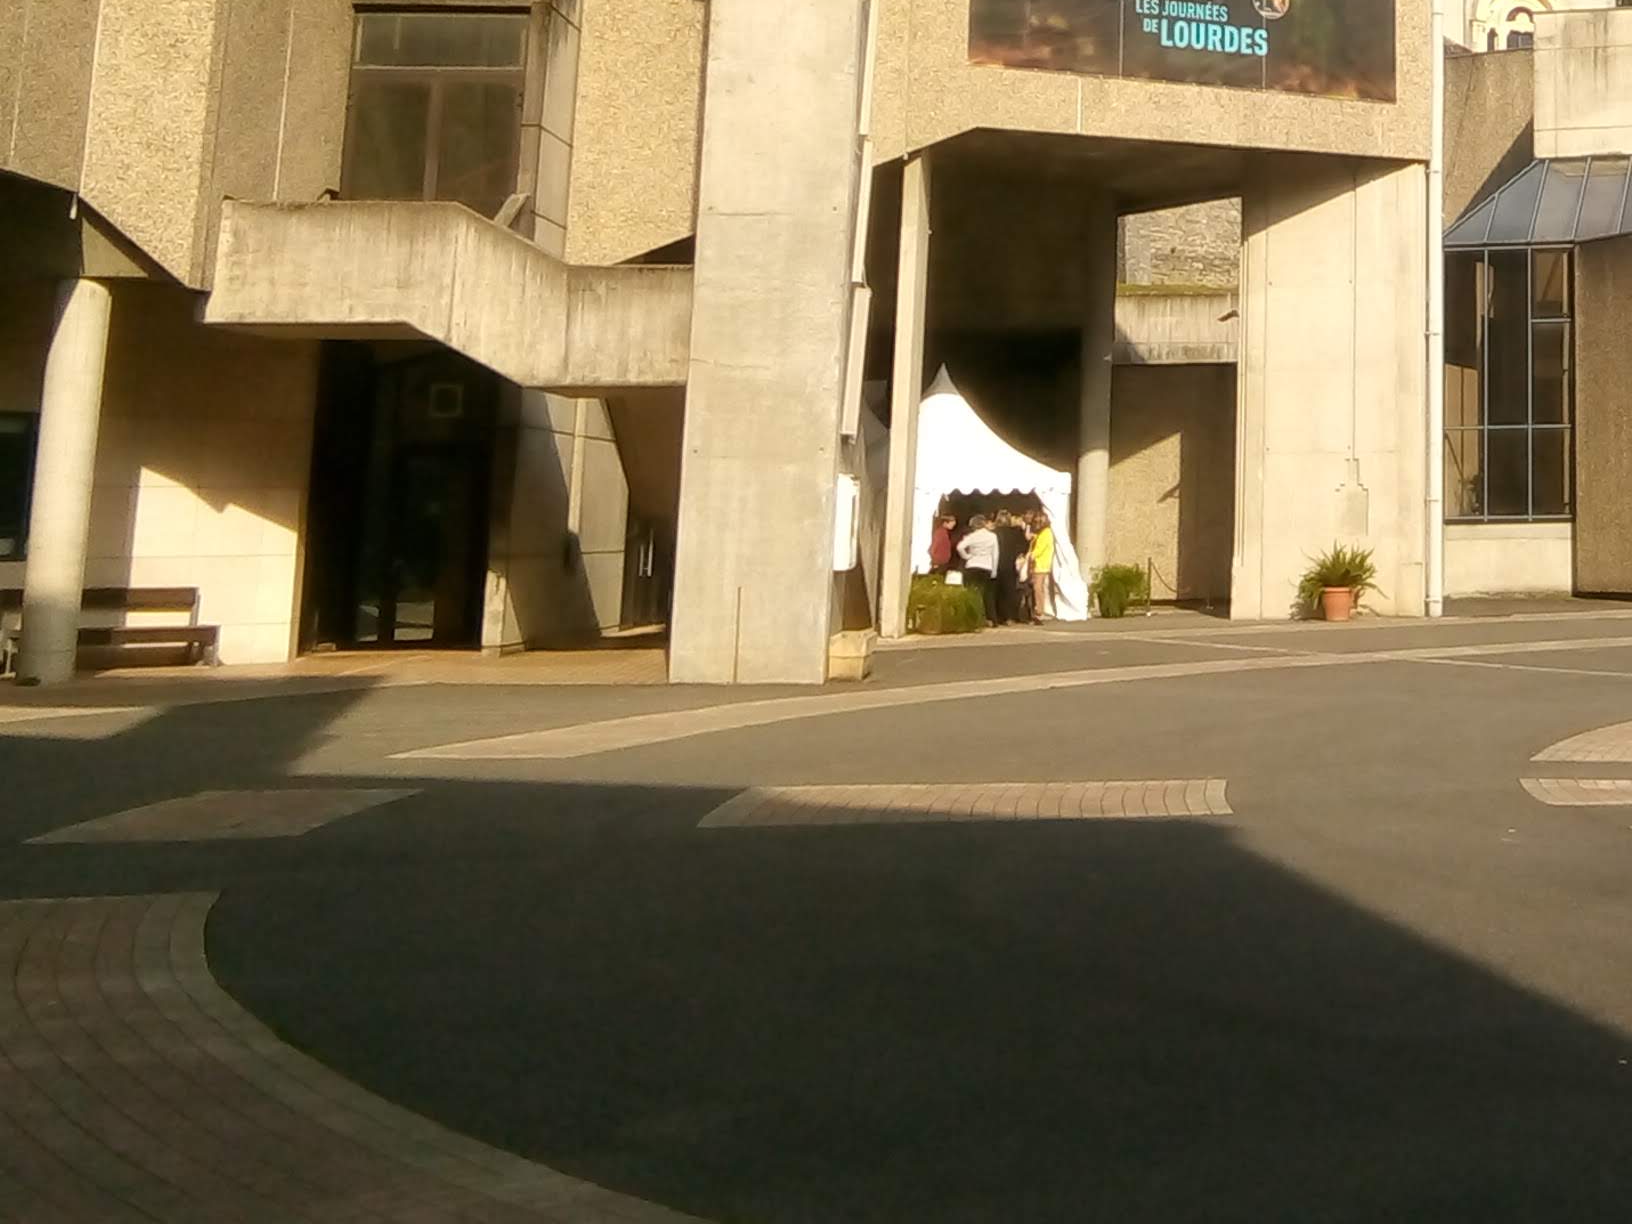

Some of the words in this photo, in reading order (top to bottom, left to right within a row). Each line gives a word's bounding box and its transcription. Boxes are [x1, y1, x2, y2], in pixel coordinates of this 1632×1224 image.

[1162, 0, 1229, 22] JOURNÉES
[1143, 18, 1159, 33] DE
[1160, 18, 1268, 56] LOURDES
